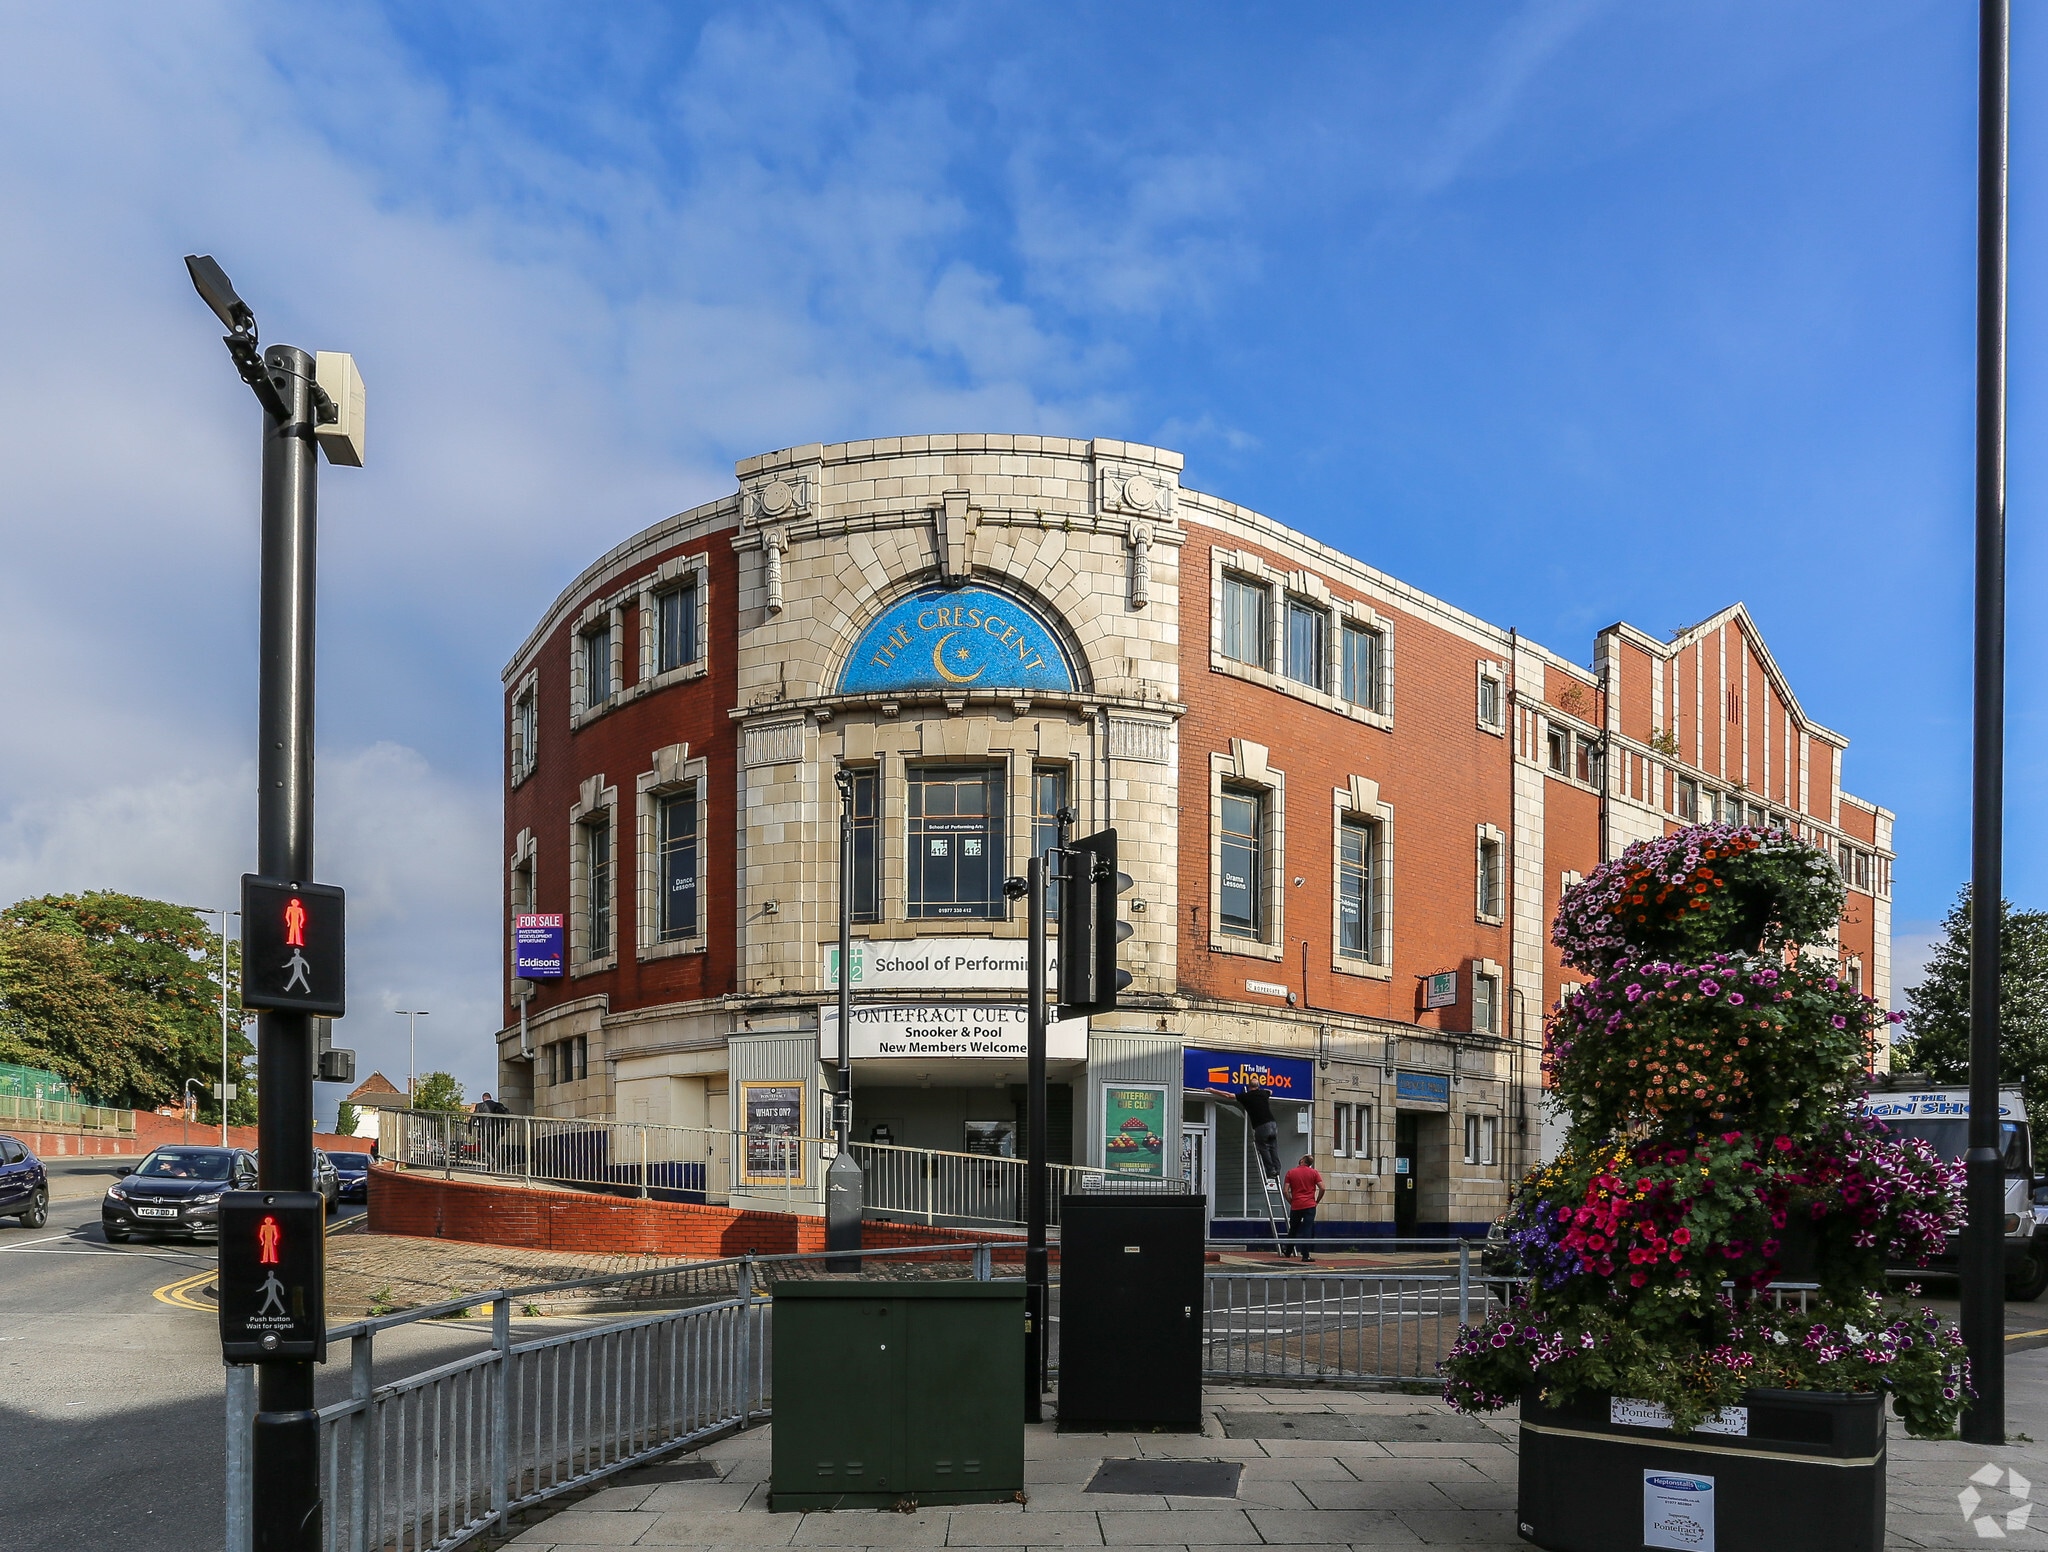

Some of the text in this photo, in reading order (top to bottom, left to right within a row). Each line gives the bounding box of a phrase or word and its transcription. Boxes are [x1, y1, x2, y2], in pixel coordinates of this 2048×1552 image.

[870, 607, 1046, 671] THE CRESCENT
[931, 847, 948, 856] 412
[965, 847, 981, 855] 412
[675, 877, 693, 886] Dance
[1225, 873, 1244, 883] Drama
[672, 882, 695, 892] Lessons
[1223, 878, 1246, 890] Lessons
[520, 916, 560, 927] FOR SALE
[519, 957, 560, 967] Eddisons
[875, 956, 1028, 972] School of Performi
[831, 966, 862, 982] 42
[1253, 985, 1280, 995] ROPERGATE
[1434, 983, 1450, 993] 412
[973, 1008, 1009, 1023] CUE
[905, 1026, 1002, 1038] Snooker & Pool
[879, 1041, 1028, 1053] New Members Welcome
[1243, 1064, 1268, 1073] The little
[1908, 1094, 1947, 1102] THE
[756, 1107, 791, 1117] WHAT'S ON?
[273, 1323, 295, 1331] signal
[1653, 1477, 1694, 1488] Heptonstalls
[1653, 1522, 1697, 1535] Pontefract
